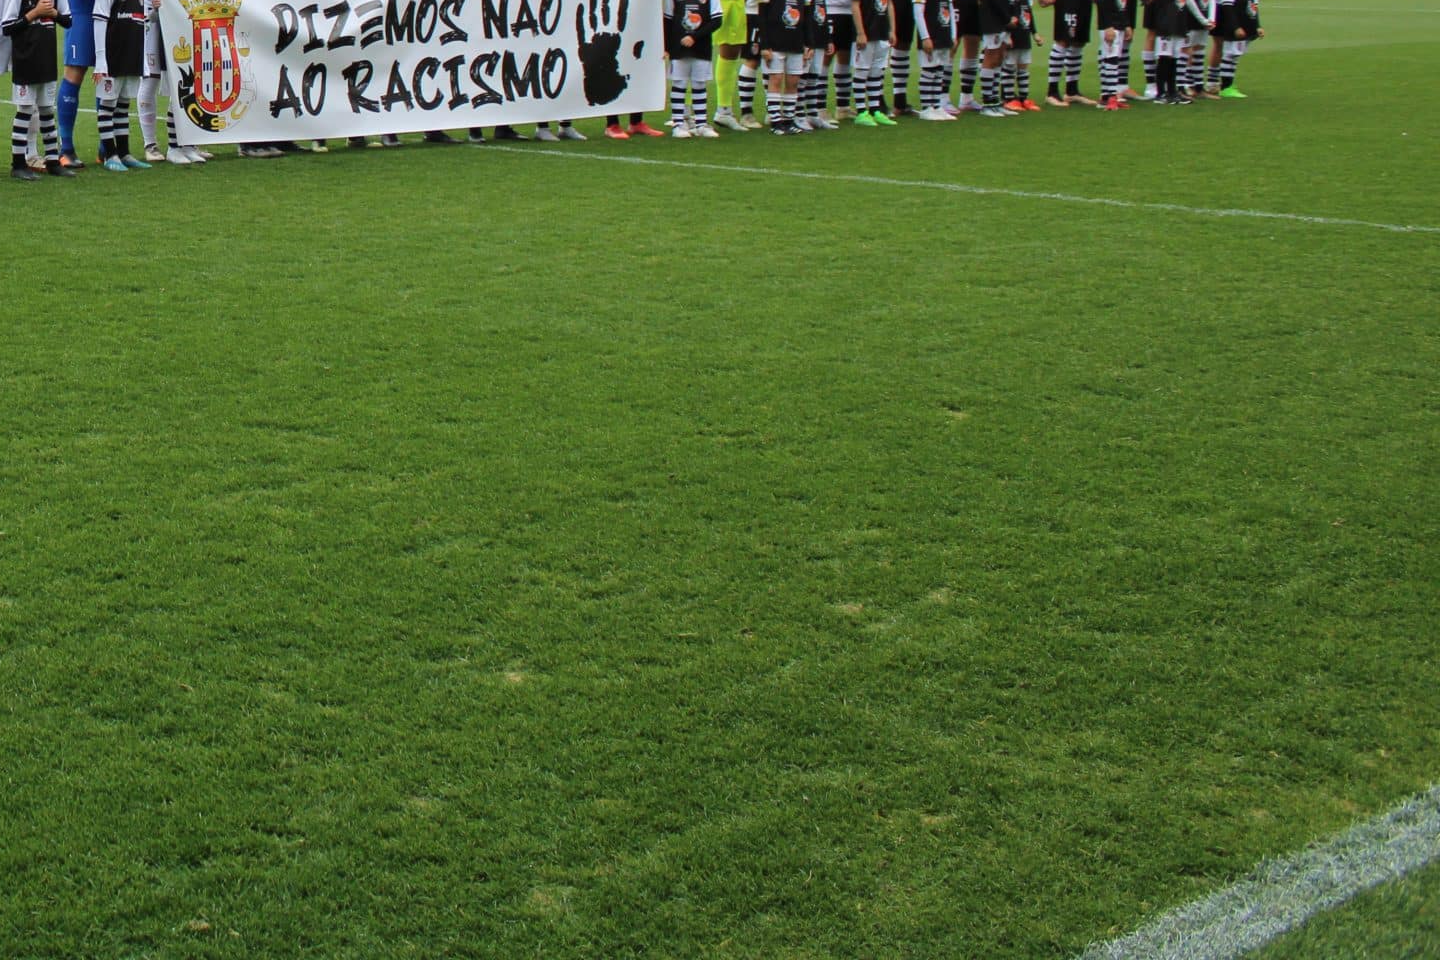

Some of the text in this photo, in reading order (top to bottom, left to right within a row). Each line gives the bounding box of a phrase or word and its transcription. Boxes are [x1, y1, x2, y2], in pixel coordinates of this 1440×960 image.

[1064, 12, 1077, 27] 45
[71, 44, 77, 59] 1
[269, 46, 568, 119] AO RACISMO
